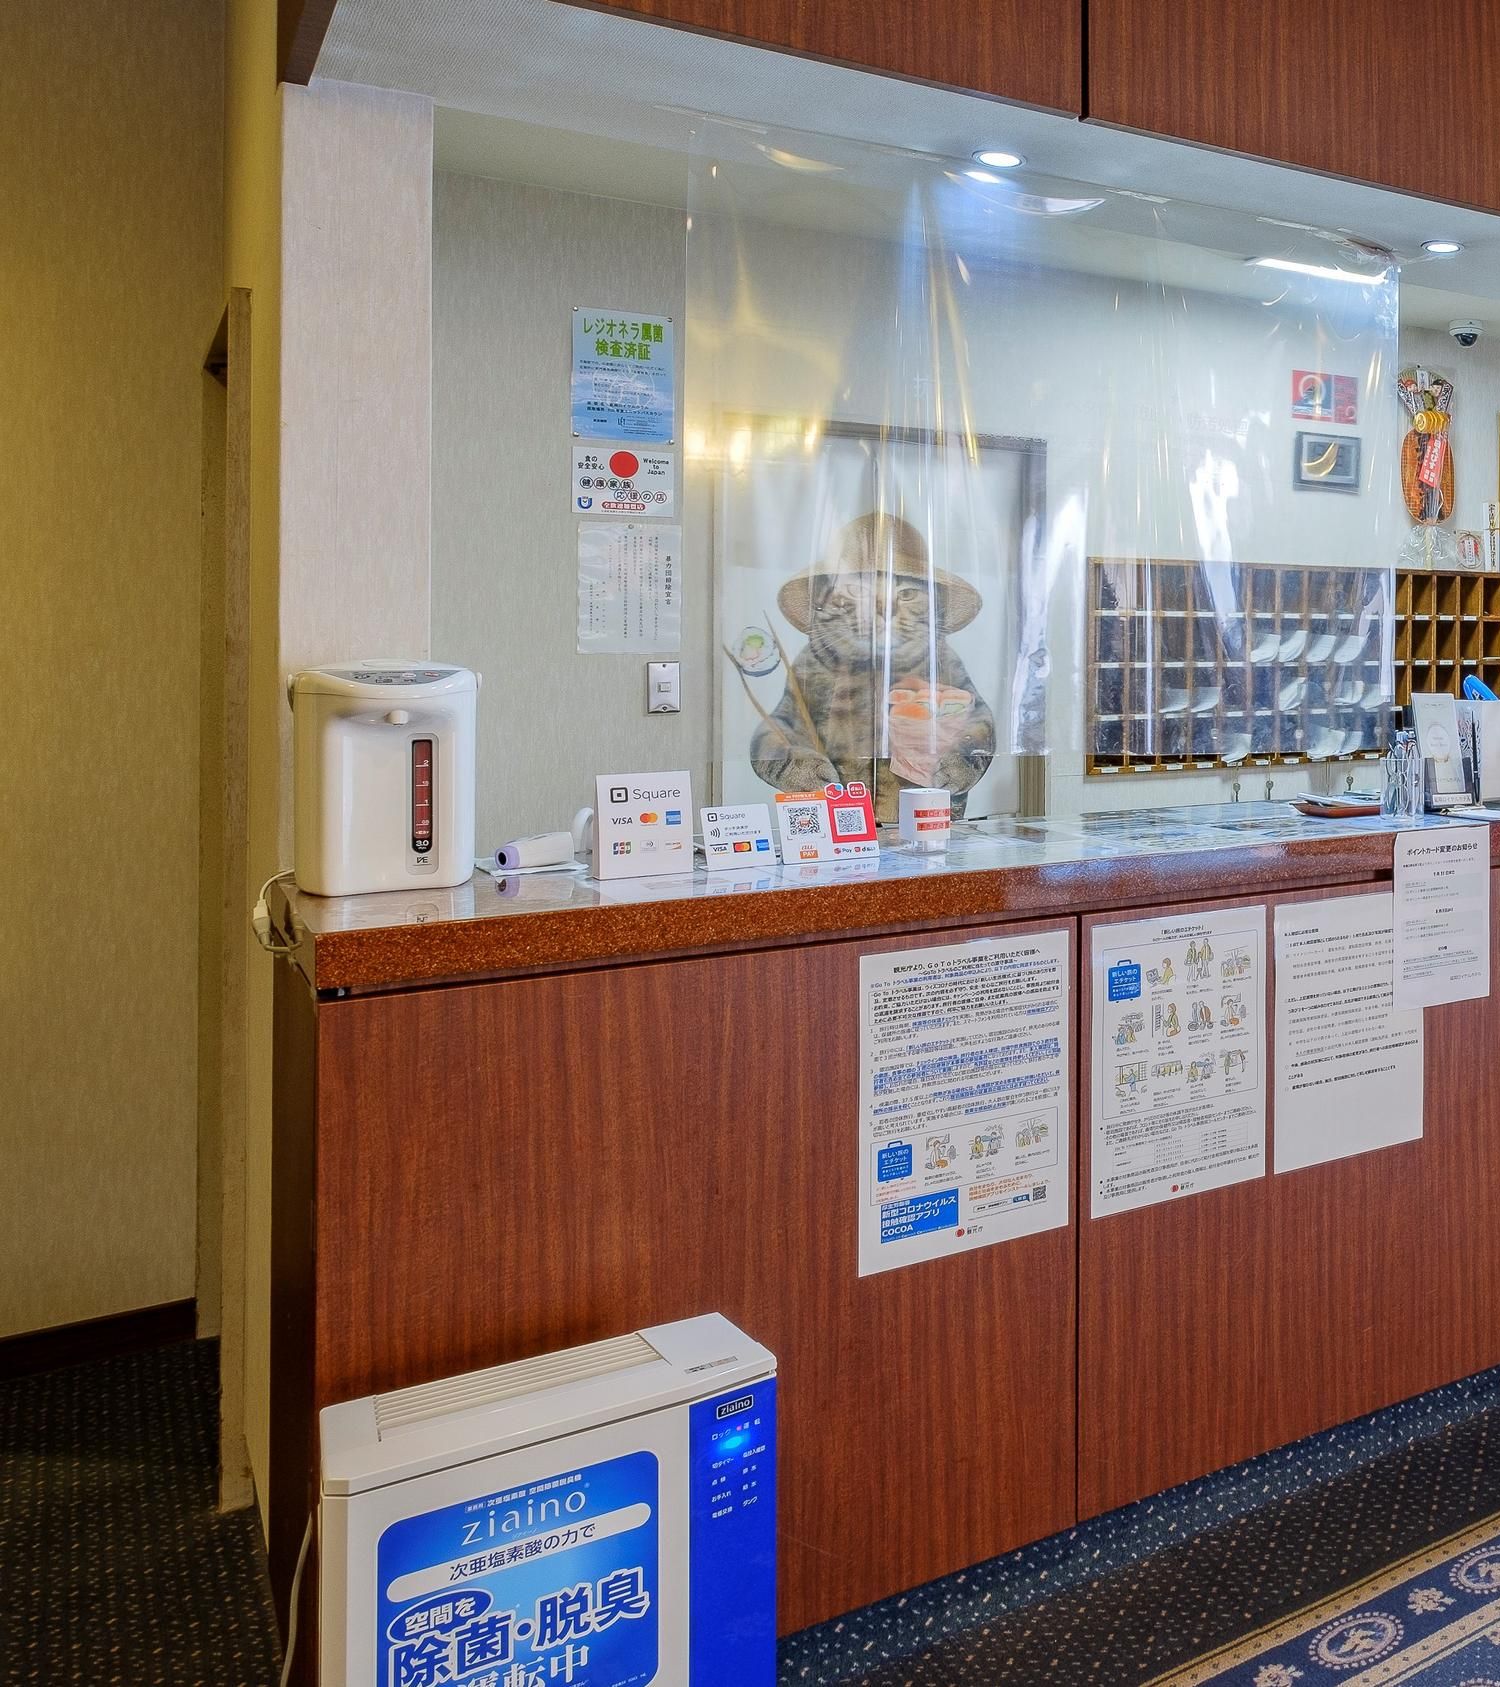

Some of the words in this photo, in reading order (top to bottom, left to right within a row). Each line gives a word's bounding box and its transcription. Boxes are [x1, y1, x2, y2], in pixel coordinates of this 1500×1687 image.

[583, 317, 663, 343] レジオネラ属菌
[595, 339, 651, 360] 検査済証
[577, 462, 605, 470] 安全安心
[632, 788, 681, 801] Square
[1406, 842, 1478, 856] ポイントカード変更のお知らせ
[1113, 975, 1137, 984] エチケット
[882, 1149, 909, 1159] 新しい旅の
[884, 1156, 907, 1165] エチケット
[882, 1196, 957, 1219] 新型コロナウイルス
[882, 1208, 940, 1228] 接触確認アプリ
[882, 1224, 914, 1237] COCOA
[720, 1398, 751, 1415] ziaino
[712, 1428, 731, 1440] ロック
[461, 1491, 586, 1546] ziaino
[450, 1523, 596, 1580] 次亜塩素酸の力で
[405, 1597, 476, 1632] 空間を
[393, 1570, 648, 1687] 除菌・脱臭
